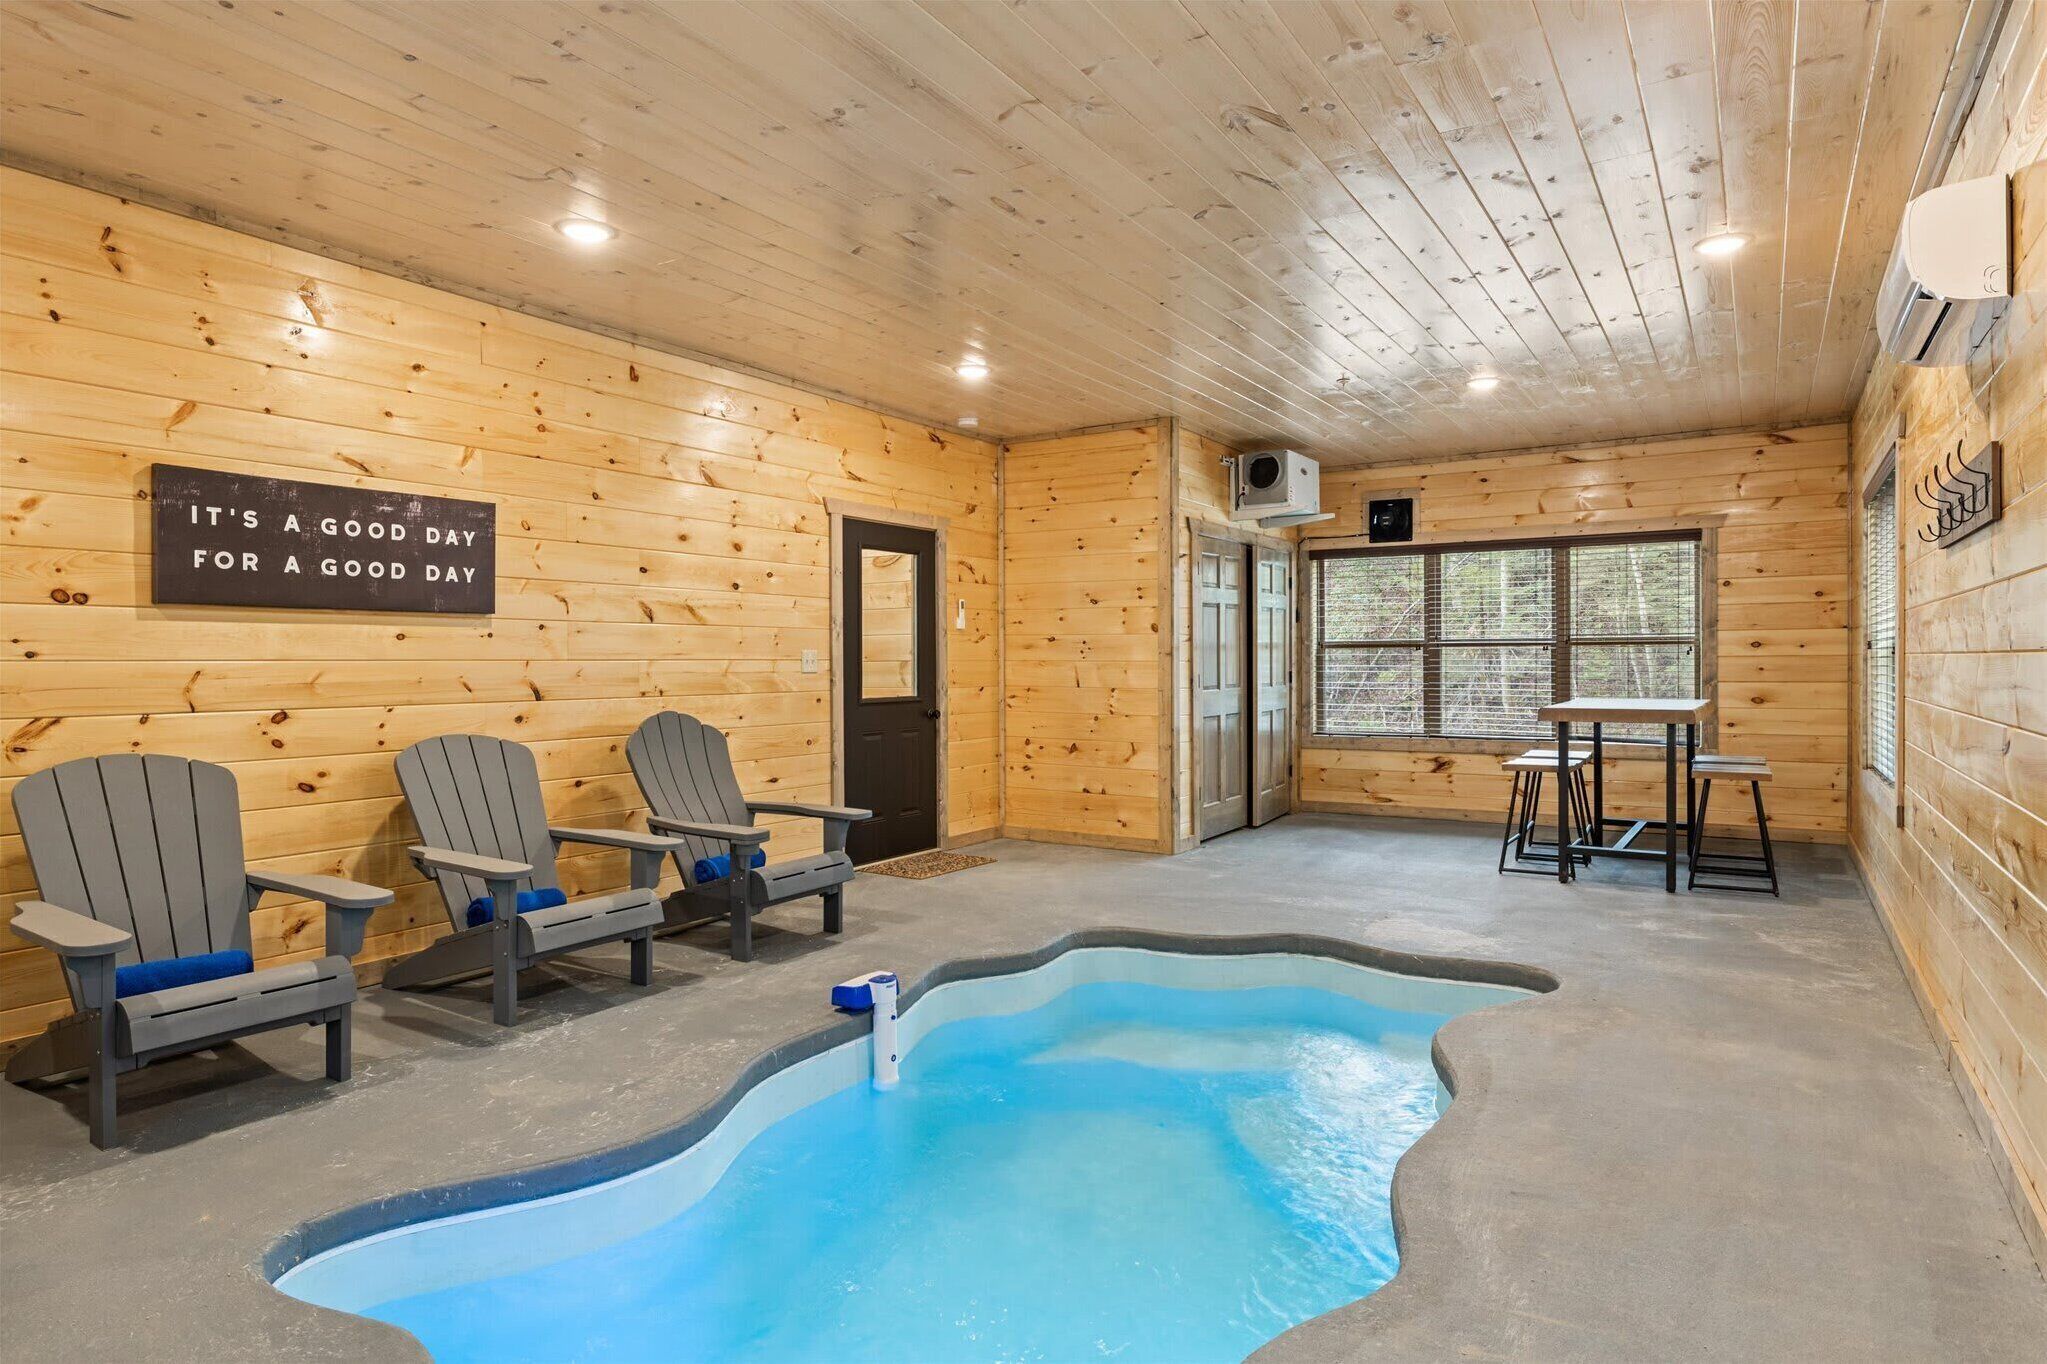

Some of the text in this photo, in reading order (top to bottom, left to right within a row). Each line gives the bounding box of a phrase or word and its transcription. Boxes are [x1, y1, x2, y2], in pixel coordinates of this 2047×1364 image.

[191, 505, 476, 547] IT'S A GOOD DAY
[193, 549, 476, 583] FOR A GOOD DAY
